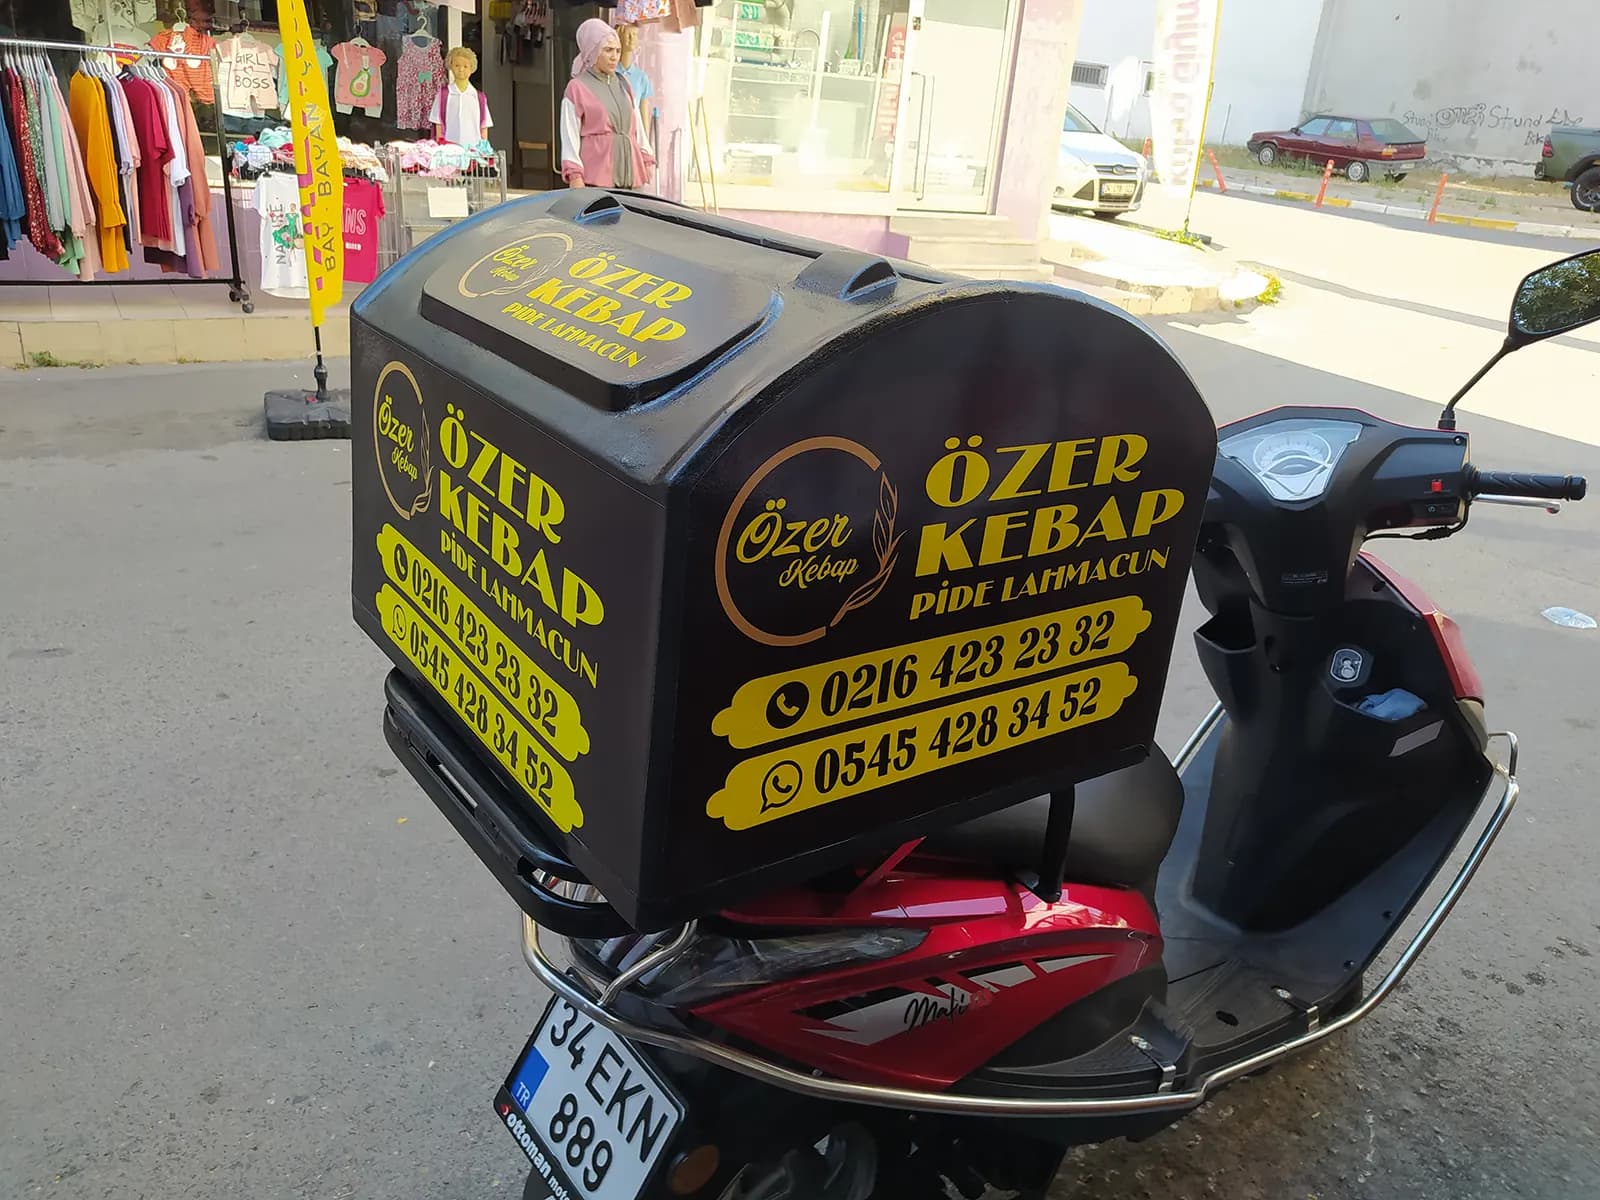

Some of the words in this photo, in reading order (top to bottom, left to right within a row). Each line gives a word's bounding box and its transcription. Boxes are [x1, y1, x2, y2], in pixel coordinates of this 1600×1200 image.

[234, 75, 270, 89] BOSS
[235, 52, 266, 66] GIRL
[306, 104, 332, 197] BAYAN
[322, 222, 336, 272] BAY
[568, 252, 693, 309] ÖZER
[502, 302, 547, 327] PİDE
[539, 317, 646, 368] LAHMACUN
[526, 277, 687, 342] KEBAP
[378, 395, 415, 452] Özer
[391, 447, 418, 482] Kebap
[439, 402, 566, 544] ÖZER
[924, 433, 1148, 508] ÖZER
[439, 470, 604, 628] KEBAP
[736, 498, 853, 563] Özer
[914, 488, 1185, 578] KEBAP
[779, 554, 859, 589] Kebap
[908, 580, 995, 621] PİDE
[1001, 546, 1170, 603] LAHMACUN
[440, 530, 477, 585] PİDE
[480, 564, 599, 689] LAHMACUN
[411, 558, 449, 626] 0216
[454, 600, 489, 666] 423
[496, 640, 521, 698] 23
[528, 675, 559, 738] 32
[820, 655, 918, 718] 0216
[930, 634, 1003, 686] 423
[1013, 622, 1060, 670] 23
[1069, 610, 1115, 657] 32
[410, 611, 449, 691] 0545
[454, 673, 488, 734] 428
[494, 713, 518, 769] 34
[525, 745, 552, 808] 52
[814, 727, 916, 793] 0545
[928, 704, 998, 757] 428
[1007, 691, 1049, 738] 34
[1059, 677, 1101, 721] 52
[516, 1081, 531, 1107] TR
[551, 1002, 594, 1070] 34
[585, 1042, 668, 1163] EKN
[506, 1113, 551, 1178] ottoman
[549, 1093, 613, 1192] 889
